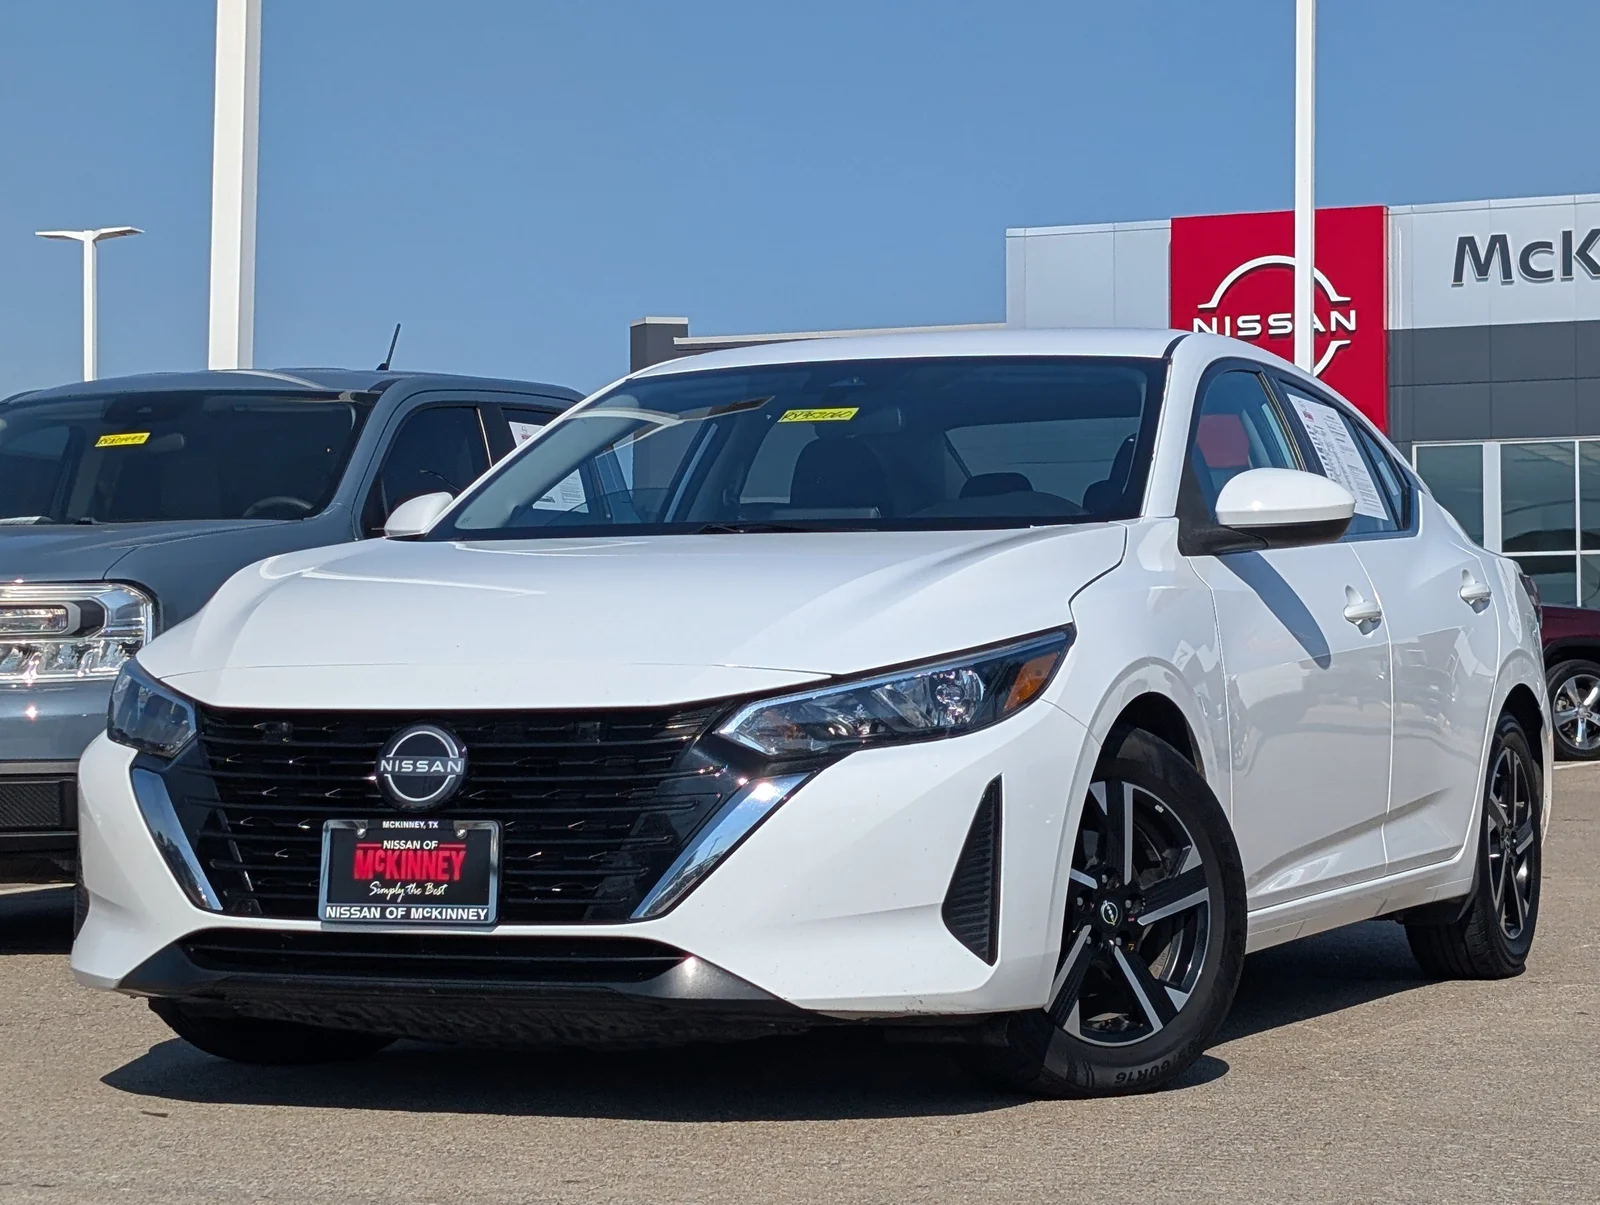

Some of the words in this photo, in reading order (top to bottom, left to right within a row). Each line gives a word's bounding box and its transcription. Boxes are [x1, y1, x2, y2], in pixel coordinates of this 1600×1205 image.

[1452, 227, 1600, 284] McK
[379, 758, 462, 774] NISSAN
[382, 820, 426, 830] MCKINNEY,
[428, 820, 439, 829] TX
[382, 840, 420, 850] NISSAN
[423, 840, 439, 850] OF
[369, 880, 405, 903] Simply
[405, 882, 423, 895] the
[424, 882, 448, 896] Best
[325, 906, 381, 919] NISSAN
[385, 907, 406, 919] OF
